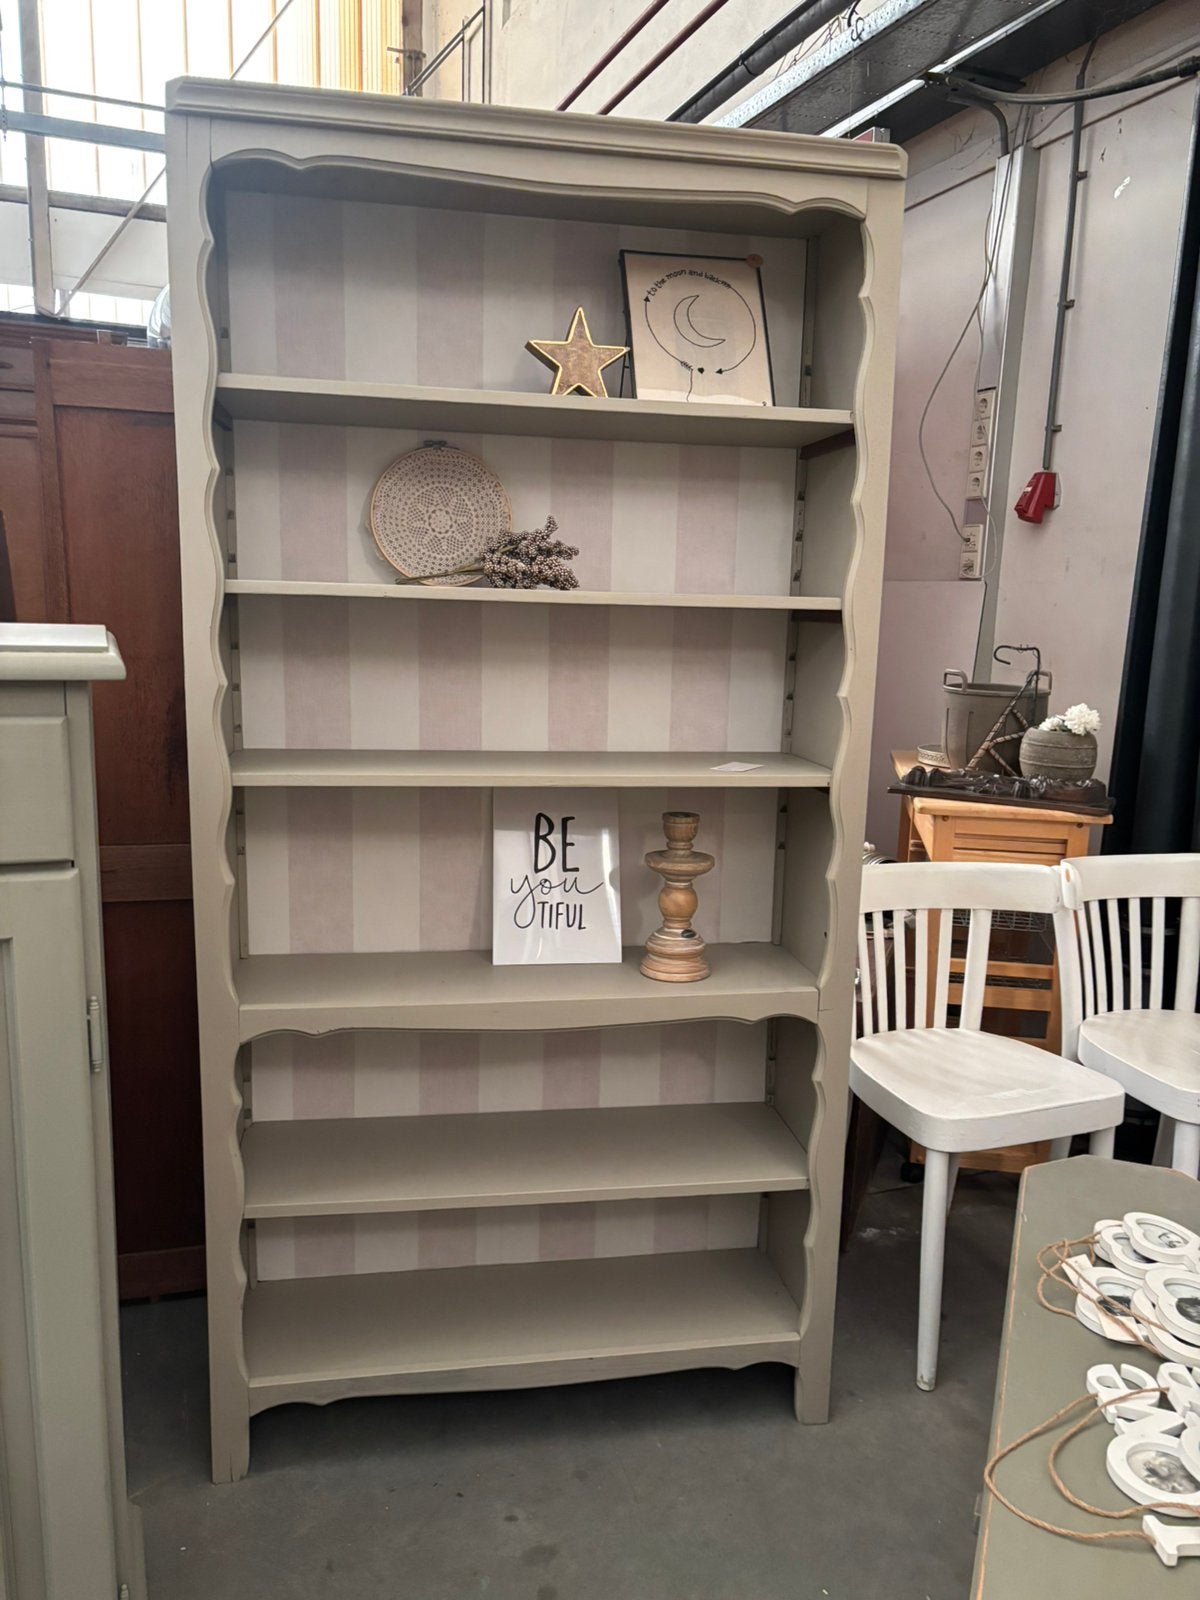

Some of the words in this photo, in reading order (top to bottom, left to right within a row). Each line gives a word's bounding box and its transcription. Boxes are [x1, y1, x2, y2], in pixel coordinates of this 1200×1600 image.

[647, 287, 658, 296] to
[654, 278, 667, 289] the
[666, 269, 687, 280] moon
[688, 269, 703, 277] and
[533, 812, 580, 874] BE
[510, 874, 604, 929] you
[537, 901, 586, 930] TIFUL
